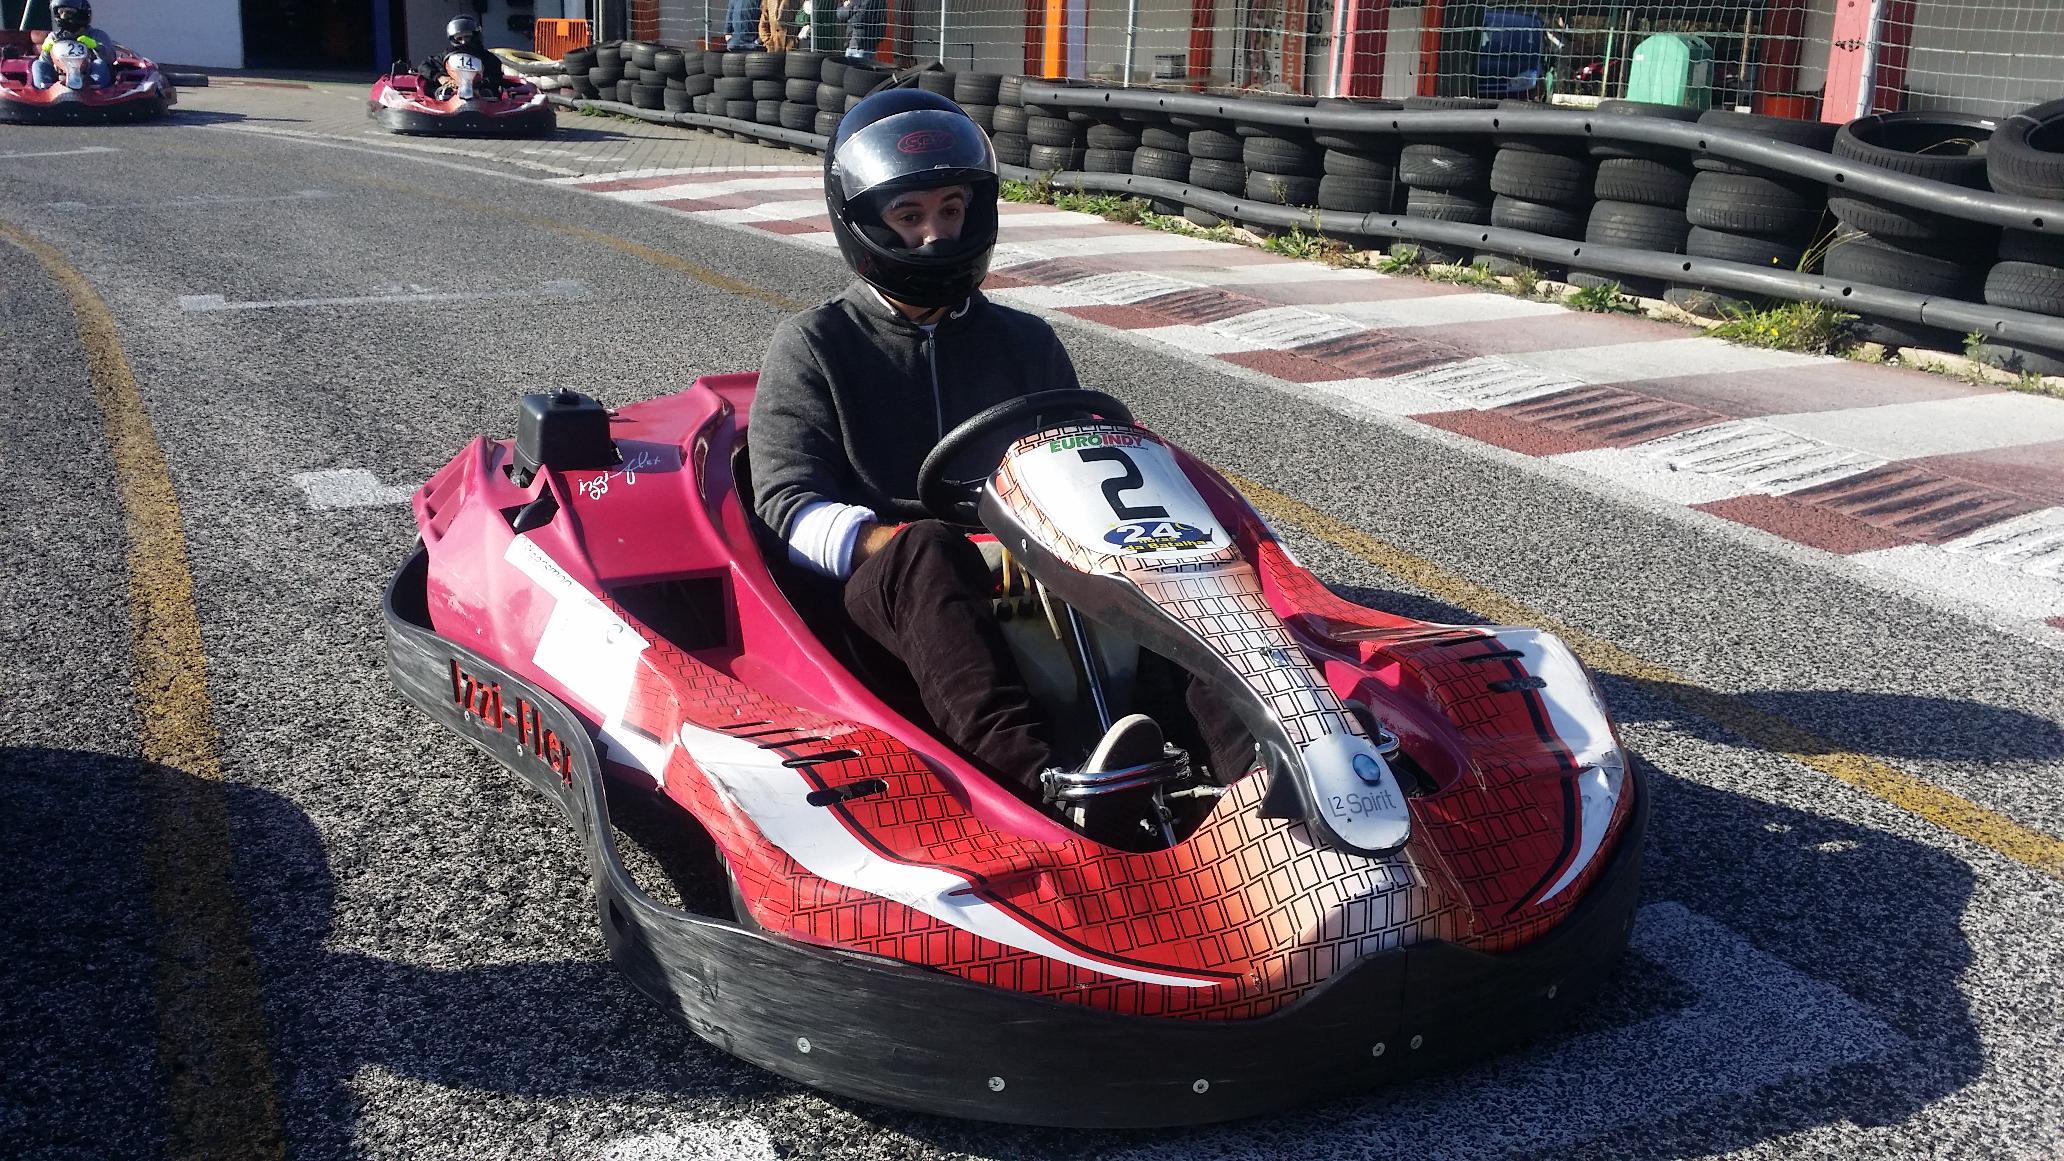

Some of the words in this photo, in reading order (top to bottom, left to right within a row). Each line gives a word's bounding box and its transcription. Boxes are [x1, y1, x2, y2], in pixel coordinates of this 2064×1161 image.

[67, 43, 85, 56] 23
[459, 56, 473, 68] 14
[1049, 433, 1144, 454] EUROINDY
[1077, 447, 1171, 521] 2
[1116, 522, 1183, 543] 24
[1148, 540, 1207, 549] Batalha
[1346, 789, 1397, 818] Spirit
